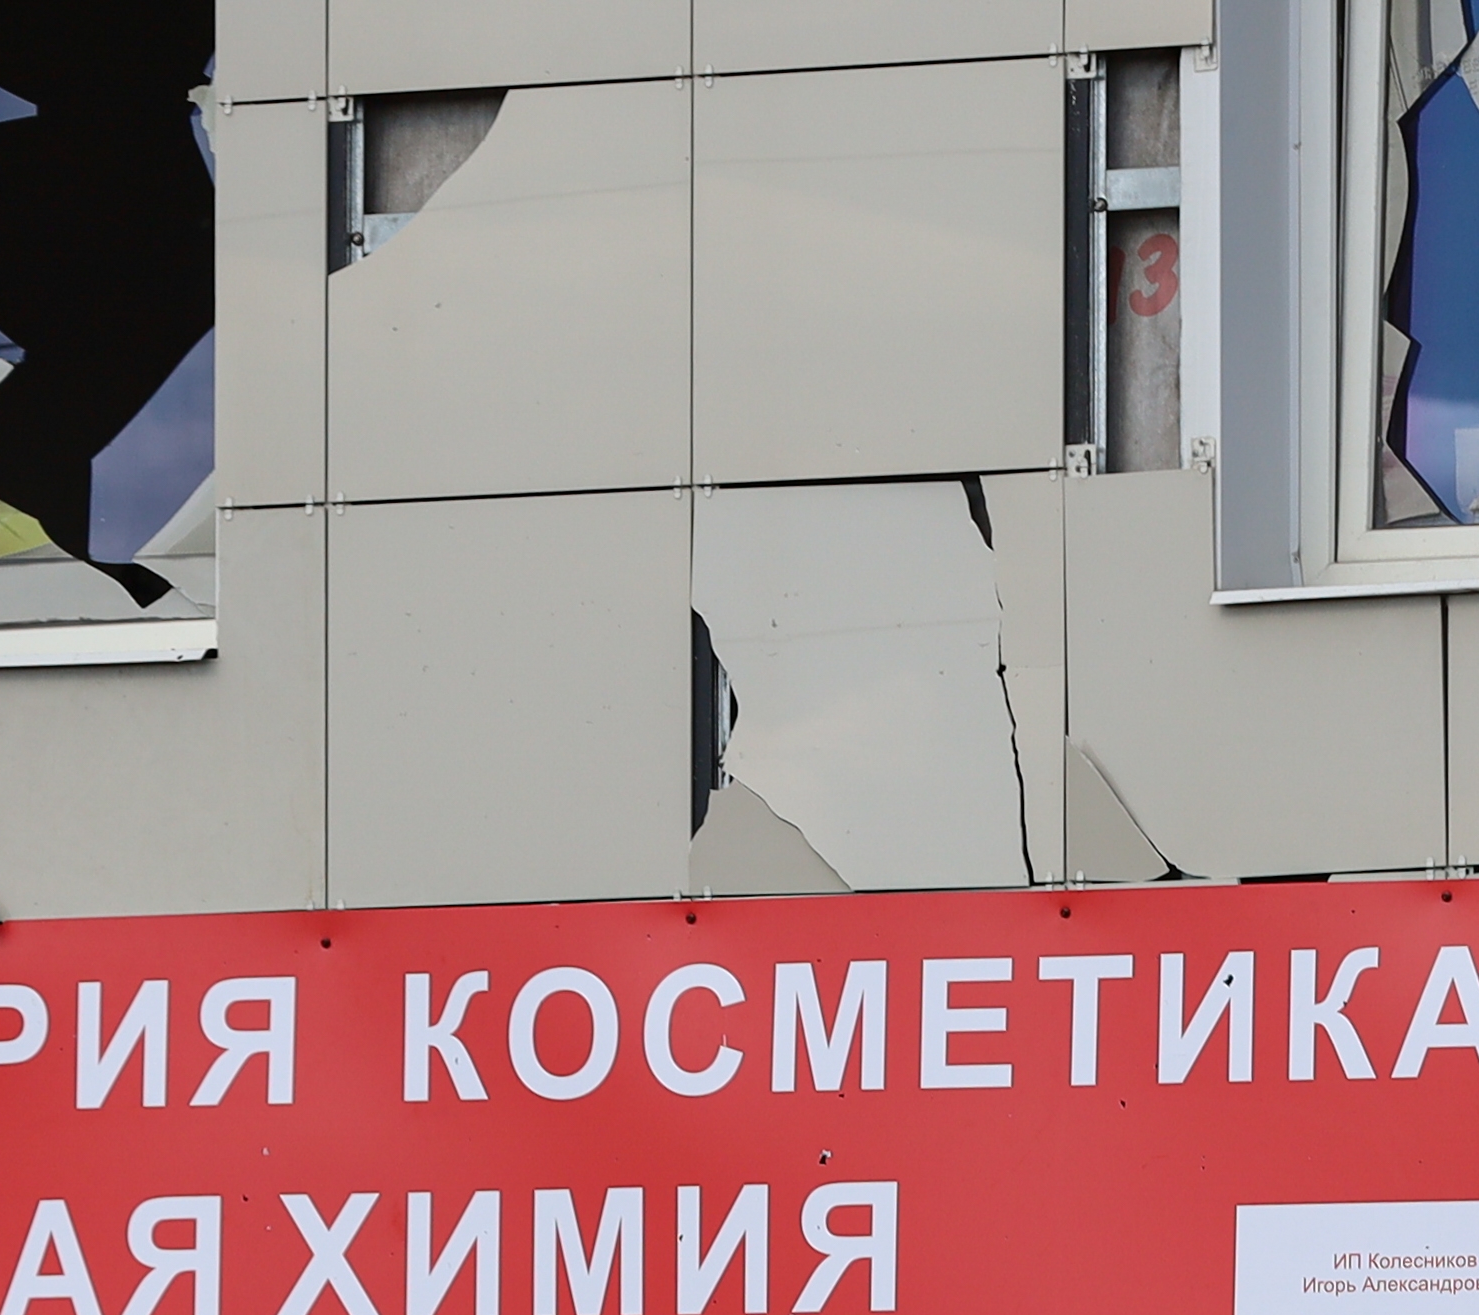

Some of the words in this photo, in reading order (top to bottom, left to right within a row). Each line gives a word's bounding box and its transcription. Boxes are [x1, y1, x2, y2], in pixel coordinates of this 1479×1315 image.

[1333, 1252, 1362, 1269] ИП
[1367, 1252, 1478, 1270] Колесников
[1302, 1277, 1357, 1297] Игорь
